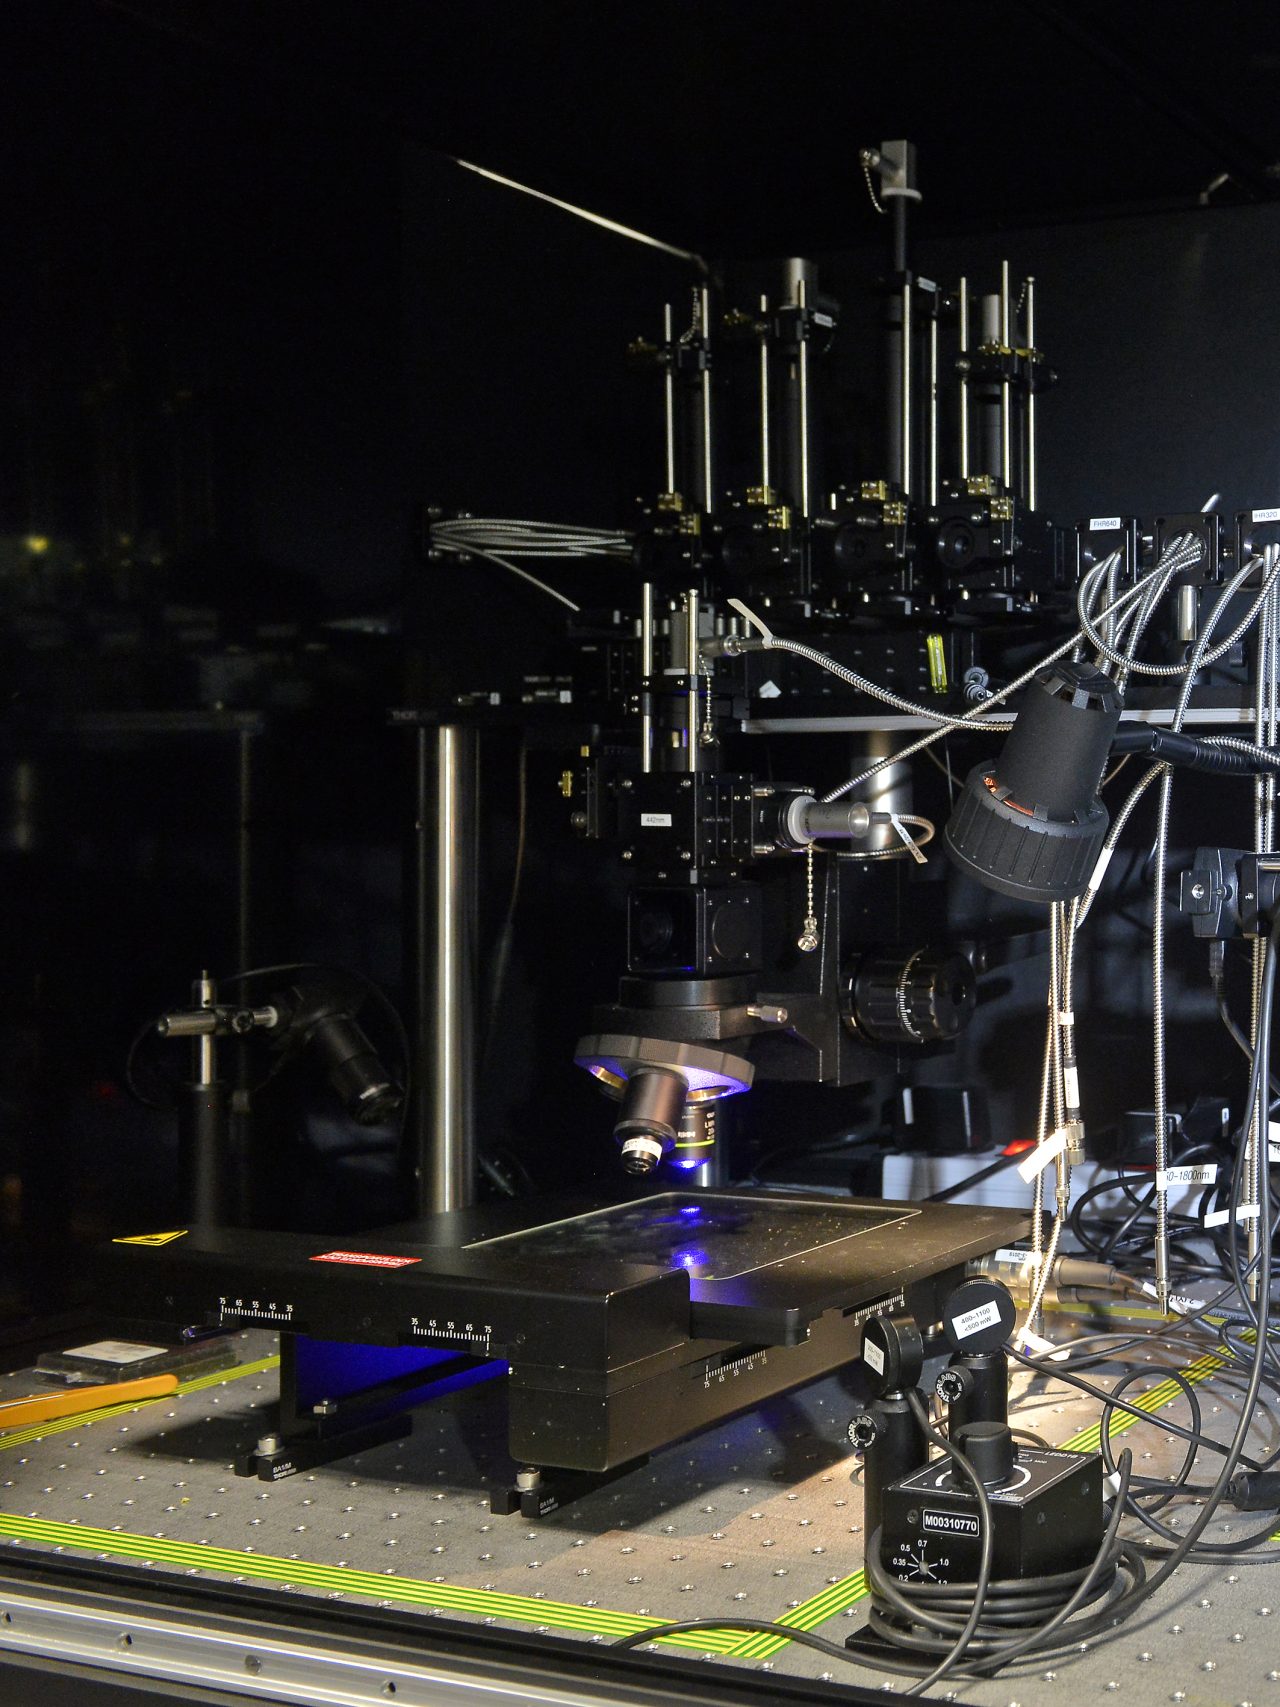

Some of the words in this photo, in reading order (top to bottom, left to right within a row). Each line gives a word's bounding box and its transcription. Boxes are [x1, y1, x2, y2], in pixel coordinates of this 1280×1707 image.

[219, 1297, 226, 1305] 75
[235, 1299, 243, 1307] 65
[252, 1300, 259, 1308] 55
[268, 1302, 277, 1310] 45
[285, 1304, 294, 1312] 35
[960, 1307, 991, 1324] 400-1100
[979, 1316, 992, 1326] mW
[411, 1317, 419, 1326] 35
[428, 1319, 437, 1327] 45
[447, 1321, 455, 1329] 55
[465, 1323, 473, 1331] 65
[484, 1325, 492, 1333] 75
[703, 1380, 710, 1389] 75
[718, 1374, 725, 1382] 65
[733, 1368, 740, 1377] 55
[747, 1362, 754, 1370] 45
[761, 1357, 767, 1365] 35
[936, 1373, 957, 1403] THORLABS
[848, 1416, 872, 1448] THORLABS
[924, 1515, 978, 1532] M00310770
[900, 1543, 911, 1552] 0.5
[917, 1539, 928, 1548] 0.7
[892, 1557, 907, 1566] 0.35
[939, 1557, 950, 1566] 1.0
[898, 1574, 909, 1582] 0.2
